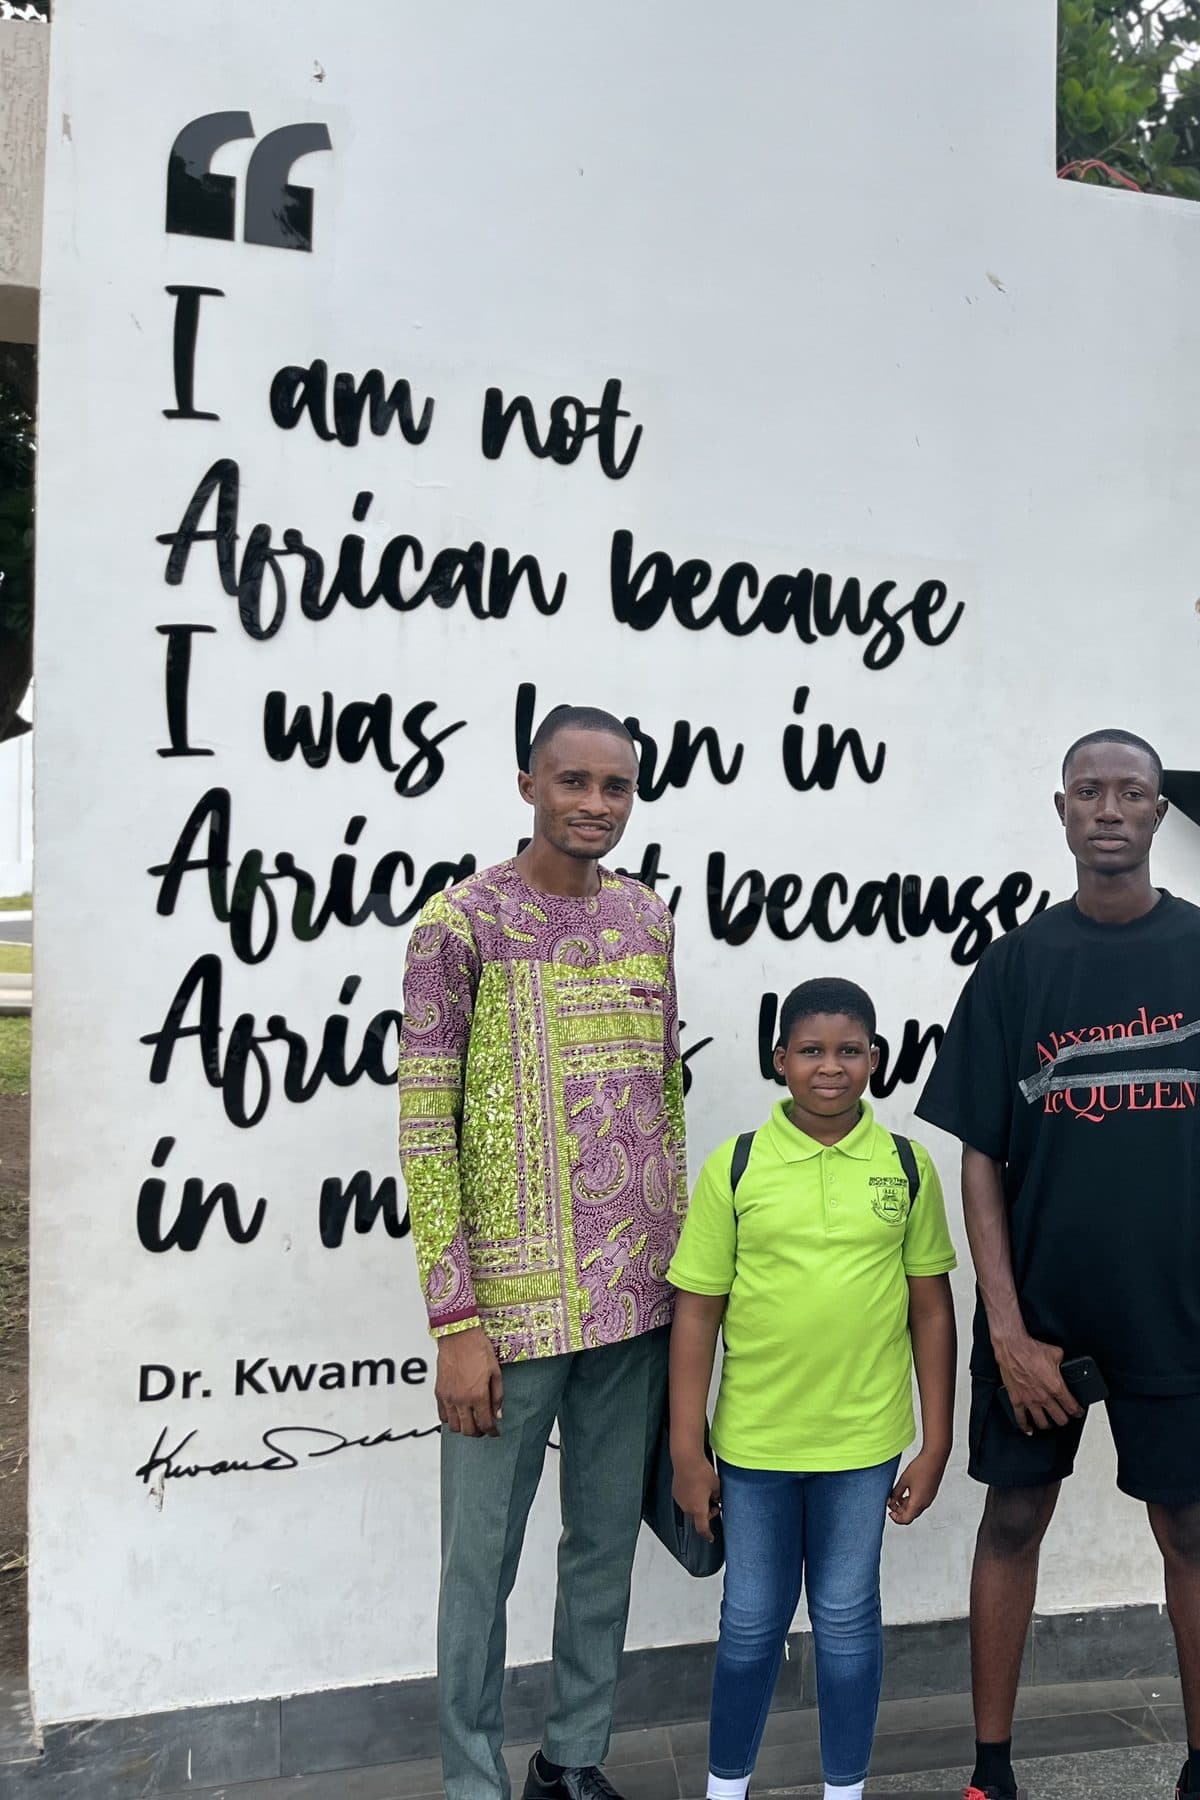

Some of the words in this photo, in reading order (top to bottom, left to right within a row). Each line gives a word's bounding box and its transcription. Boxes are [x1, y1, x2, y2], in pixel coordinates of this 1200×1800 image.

[162, 285, 225, 421] I
[270, 358, 435, 447] am
[482, 378, 643, 480] not
[155, 458, 567, 640] African
[610, 529, 965, 671] because
[156, 623, 217, 759] I
[264, 690, 468, 798] was
[782, 685, 886, 792] in
[707, 851, 1051, 966] because
[139, 953, 402, 1129] Afric
[136, 1136, 267, 1254] in
[139, 1363, 212, 1403] Dr.
[234, 1357, 428, 1397] Kwame
